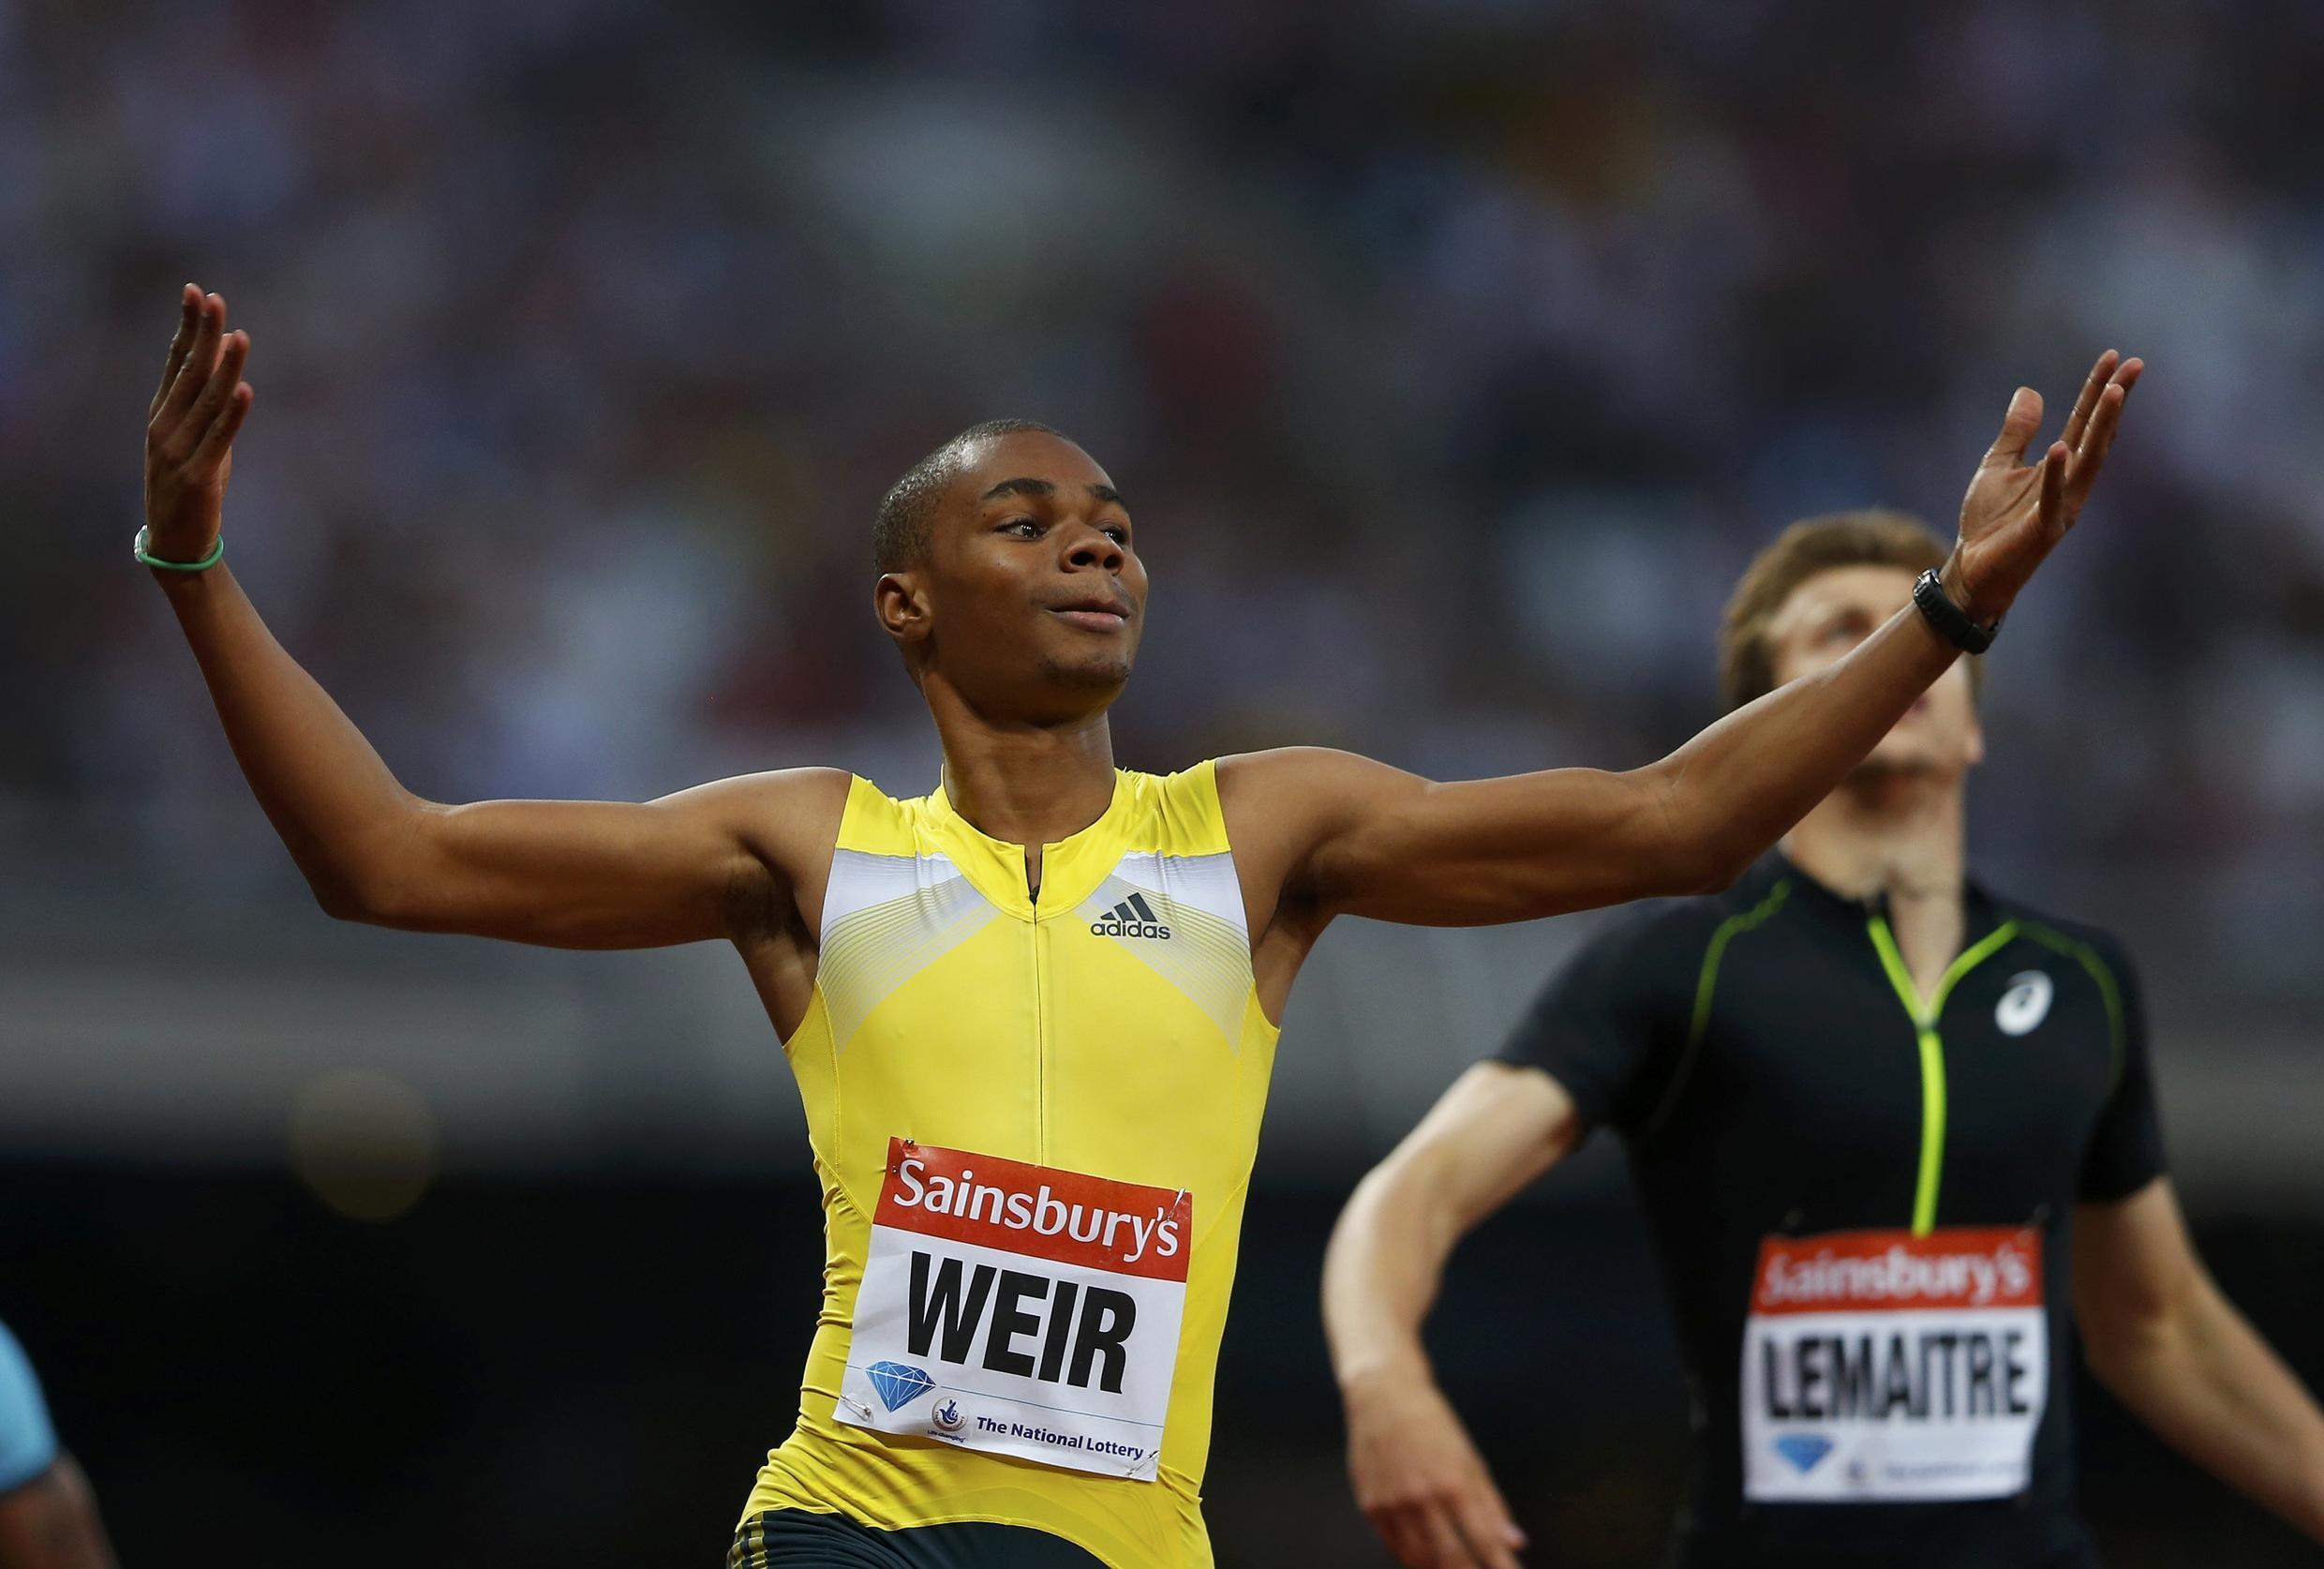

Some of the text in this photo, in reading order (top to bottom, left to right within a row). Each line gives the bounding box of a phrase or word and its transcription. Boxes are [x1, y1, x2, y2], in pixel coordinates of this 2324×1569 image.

[1090, 919, 1170, 940] adidas
[893, 1158, 1179, 1263] Sainsbury's
[1759, 1244, 2032, 1307] Sainsbury's
[907, 1250, 1137, 1395] WEIR
[1763, 1330, 2029, 1421] LEMAITRE
[976, 1416, 1007, 1433] The
[1011, 1423, 1083, 1449] National
[1086, 1437, 1143, 1461] Lottery
